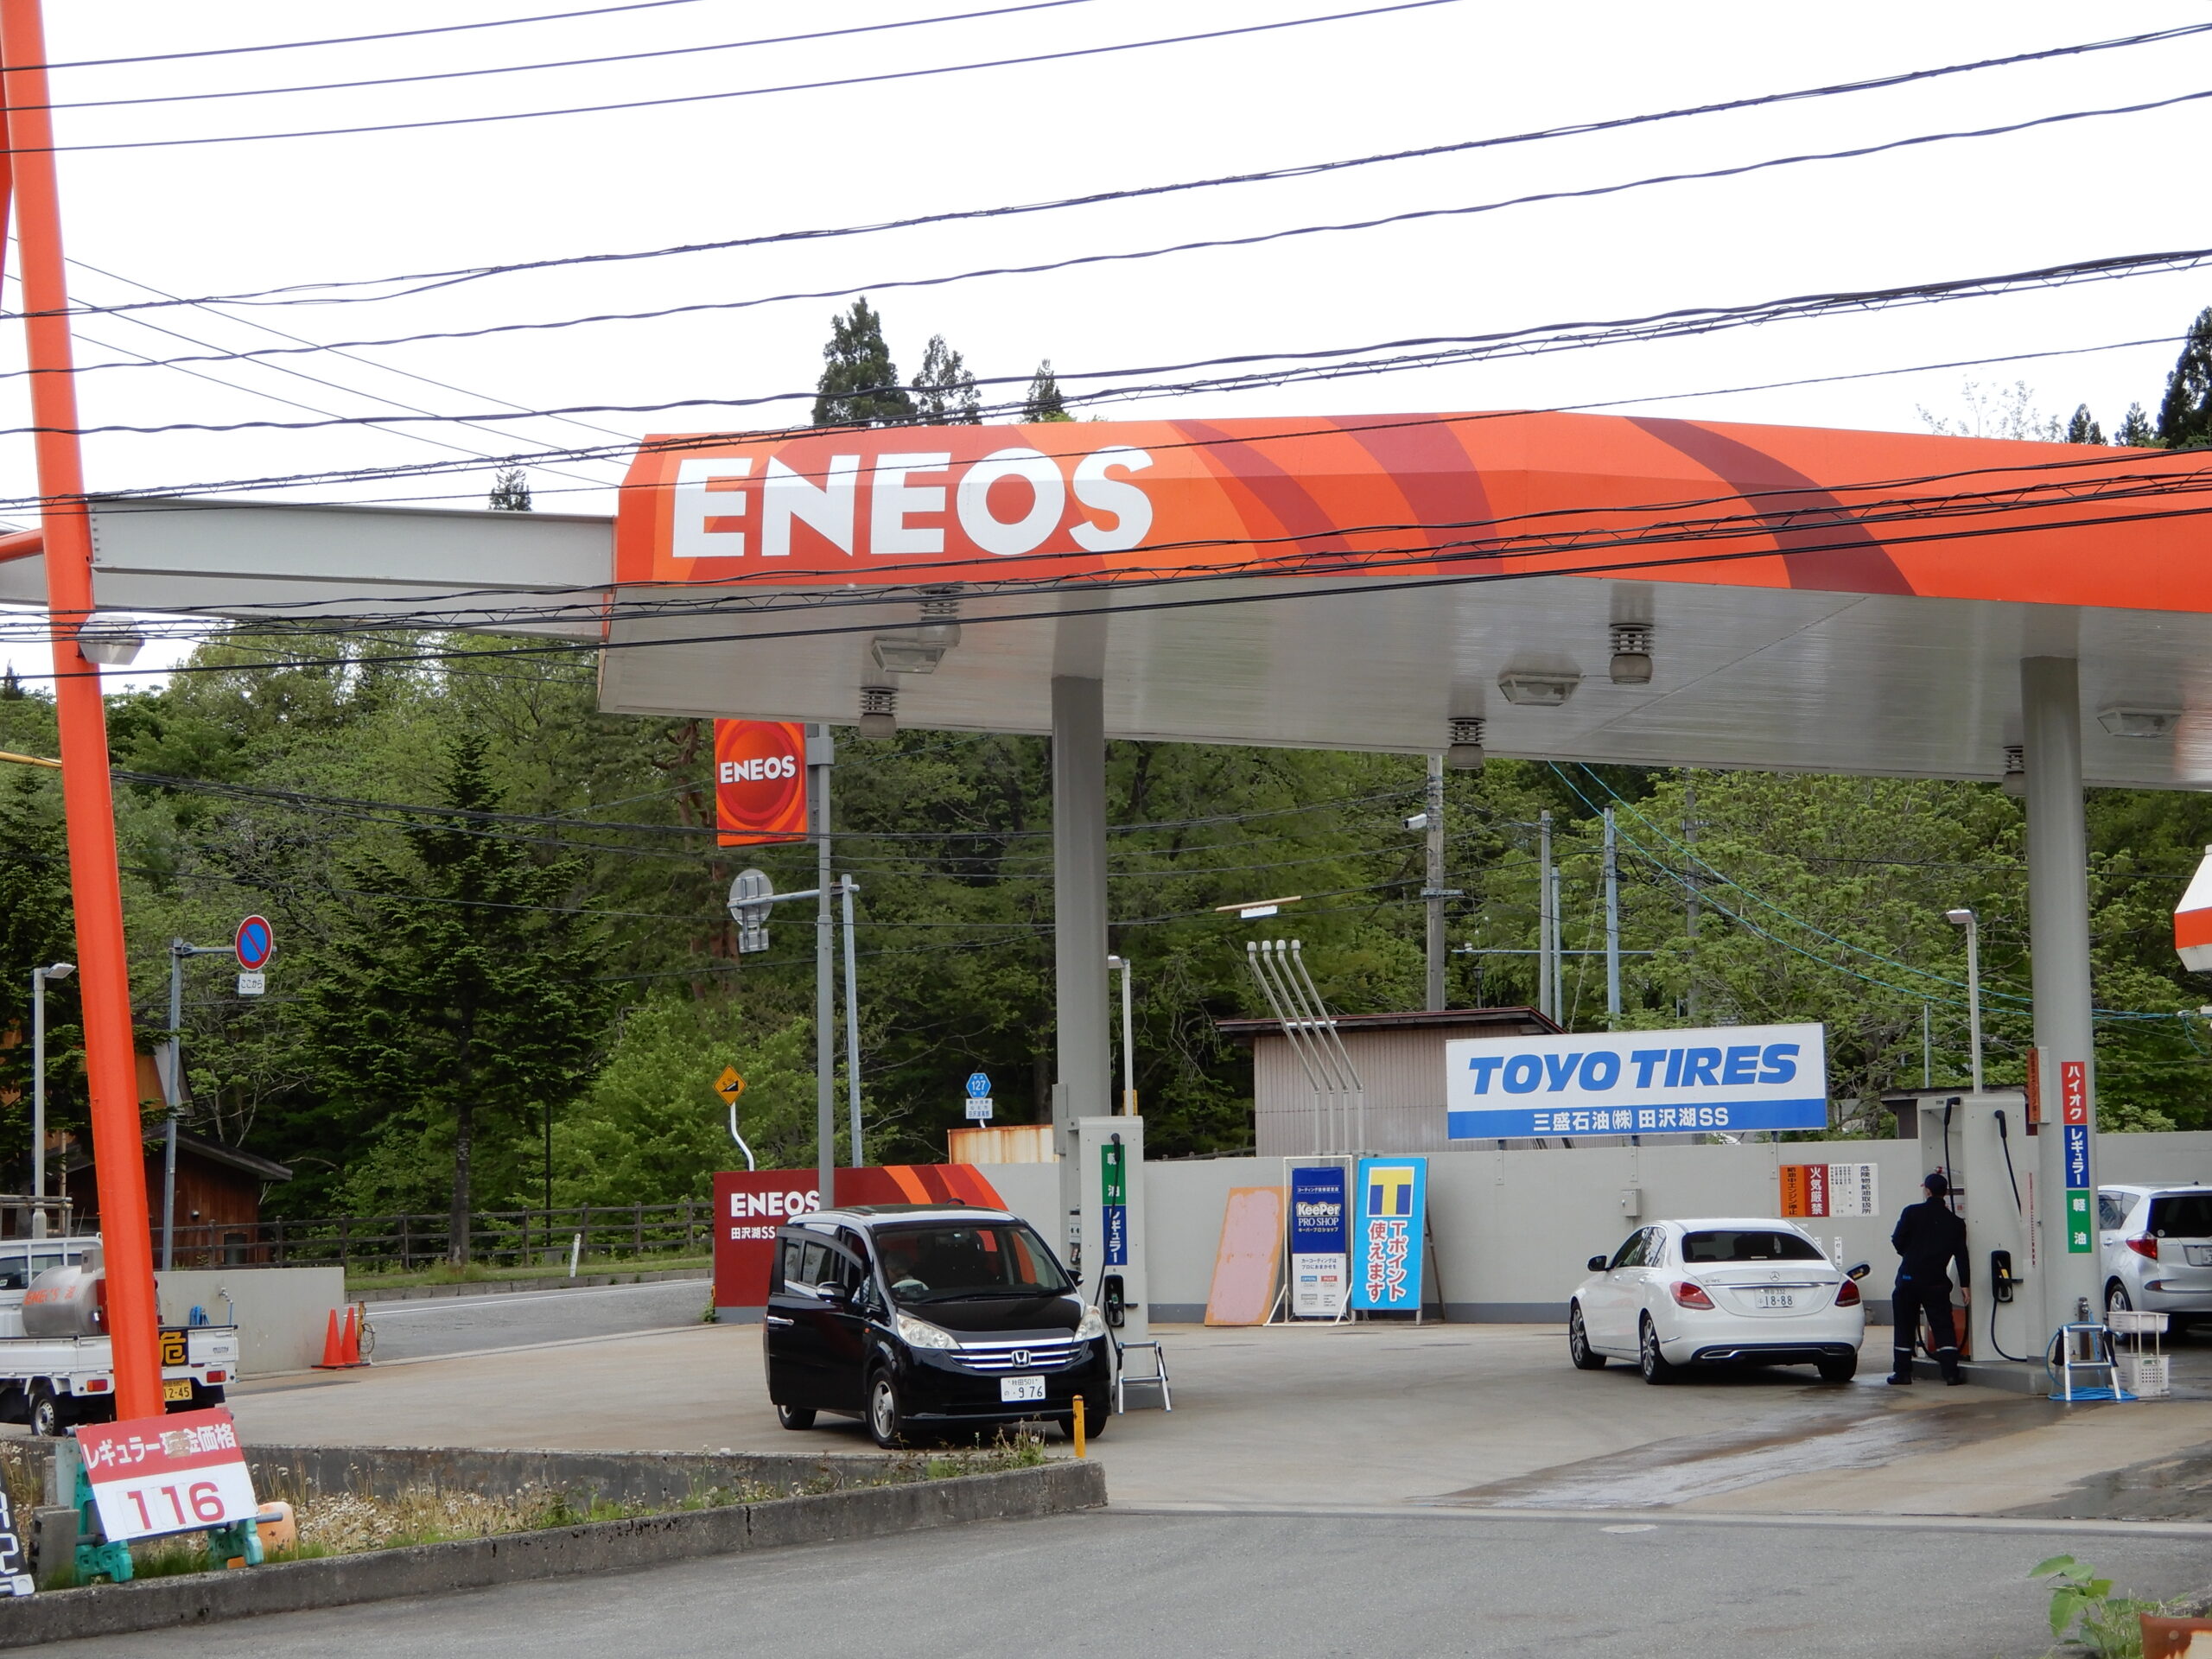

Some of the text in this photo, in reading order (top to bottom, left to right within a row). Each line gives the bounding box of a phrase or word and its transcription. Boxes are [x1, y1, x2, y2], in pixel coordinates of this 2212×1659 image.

[672, 445, 1153, 557] ENEOS
[720, 755, 796, 784] ENEOS
[241, 979, 263, 988] ここから
[1469, 1043, 1800, 1095] TOYO TIRES
[972, 1080, 986, 1090] 127
[2068, 1065, 2082, 1120] ハイオク
[1639, 1107, 1729, 1127] 田沢湖SS
[2071, 1128, 2084, 1185] レギュラー
[731, 1191, 820, 1217] ENEOS
[1810, 1166, 1822, 1215] 火気厳禁
[1297, 1203, 1341, 1216] KeePer
[731, 1226, 776, 1240] 田沢湖SS
[1367, 1221, 1388, 1302] 使えます
[1387, 1222, 1408, 1301] Tポイント
[24, 1287, 58, 1306] ENES
[1765, 1295, 1793, 1306] 18-88
[159, 1332, 187, 1364] 危
[127, 1481, 226, 1530] 116
